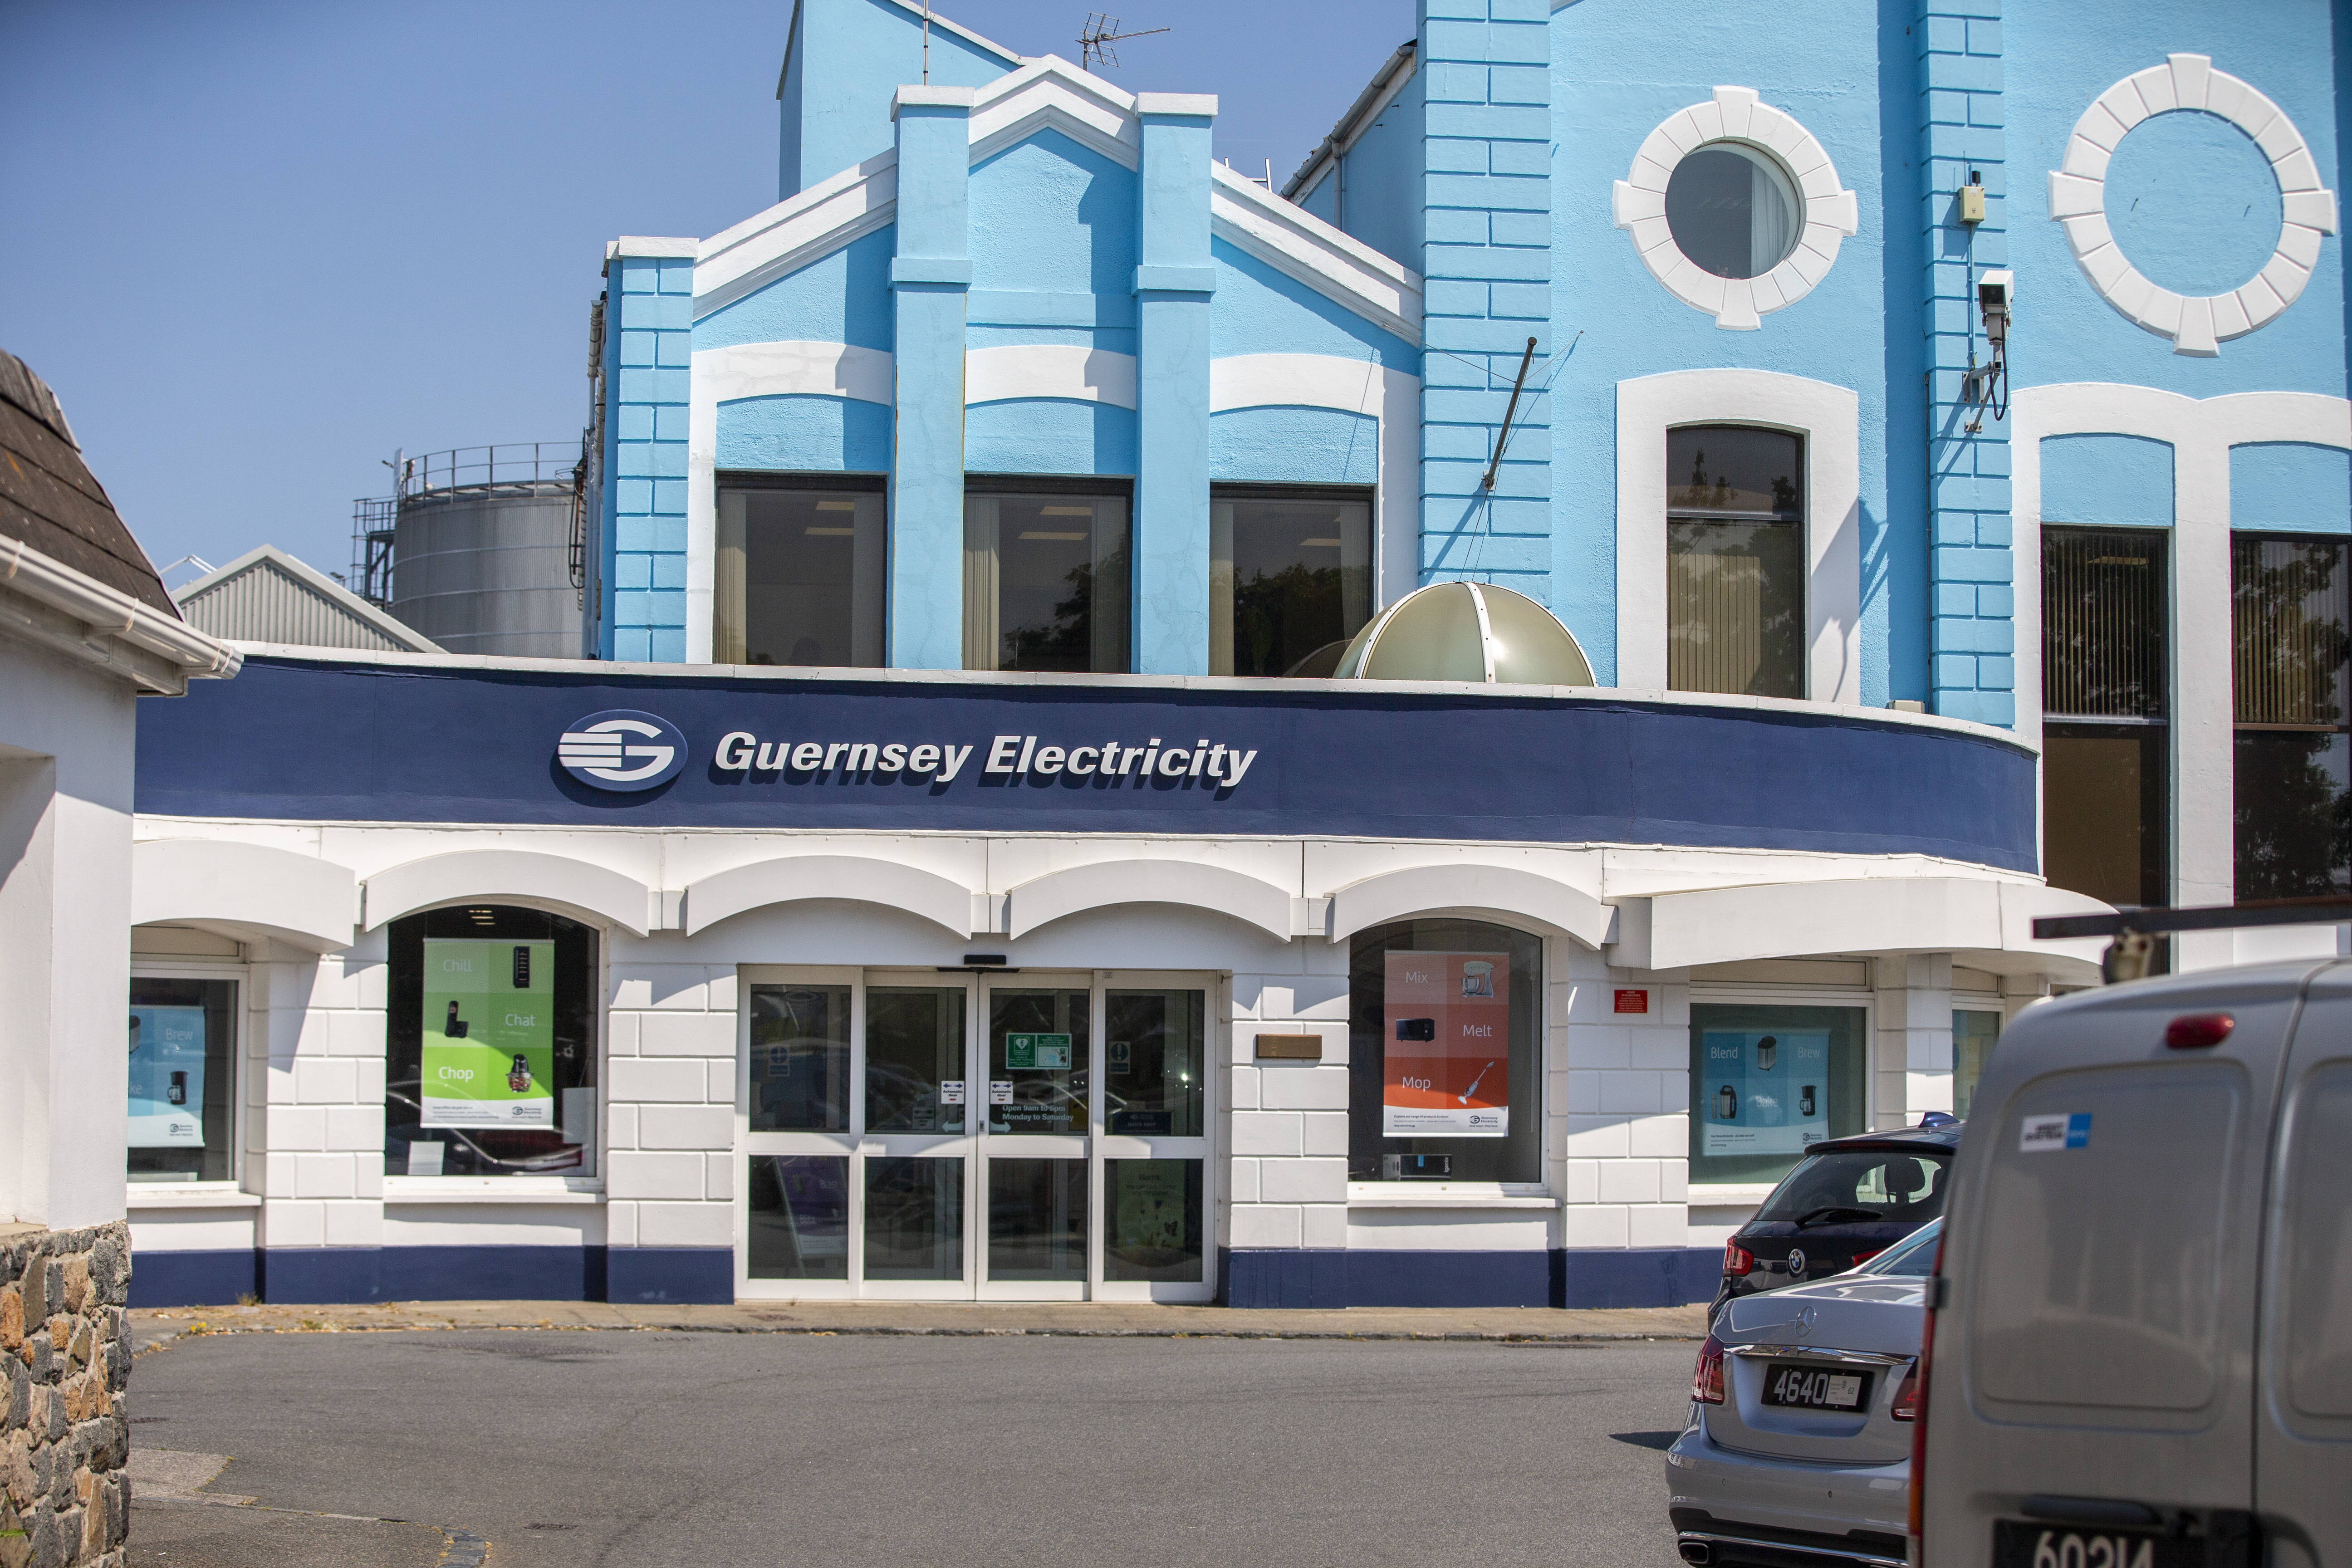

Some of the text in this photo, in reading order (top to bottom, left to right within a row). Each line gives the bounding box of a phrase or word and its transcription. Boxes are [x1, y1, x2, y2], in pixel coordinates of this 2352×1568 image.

[715, 732, 1258, 787] Guernsey Electricity
[442, 959, 471, 972] Chill
[1406, 971, 1428, 983] Mix
[505, 1014, 535, 1027] Chat
[166, 1028, 193, 1041] Brew
[1463, 1024, 1492, 1037] Melt
[1711, 1047, 1738, 1058] Blend
[1798, 1046, 1820, 1058] Brew
[438, 1067, 474, 1083] Chop
[1402, 1077, 1431, 1092] Mop
[1756, 1095, 1779, 1107] Bake
[1002, 1113, 1031, 1122] Monday
[1042, 1113, 1074, 1122] Saturday
[1774, 1371, 1828, 1404] 4640
[1847, 1387, 1855, 1395] 62
